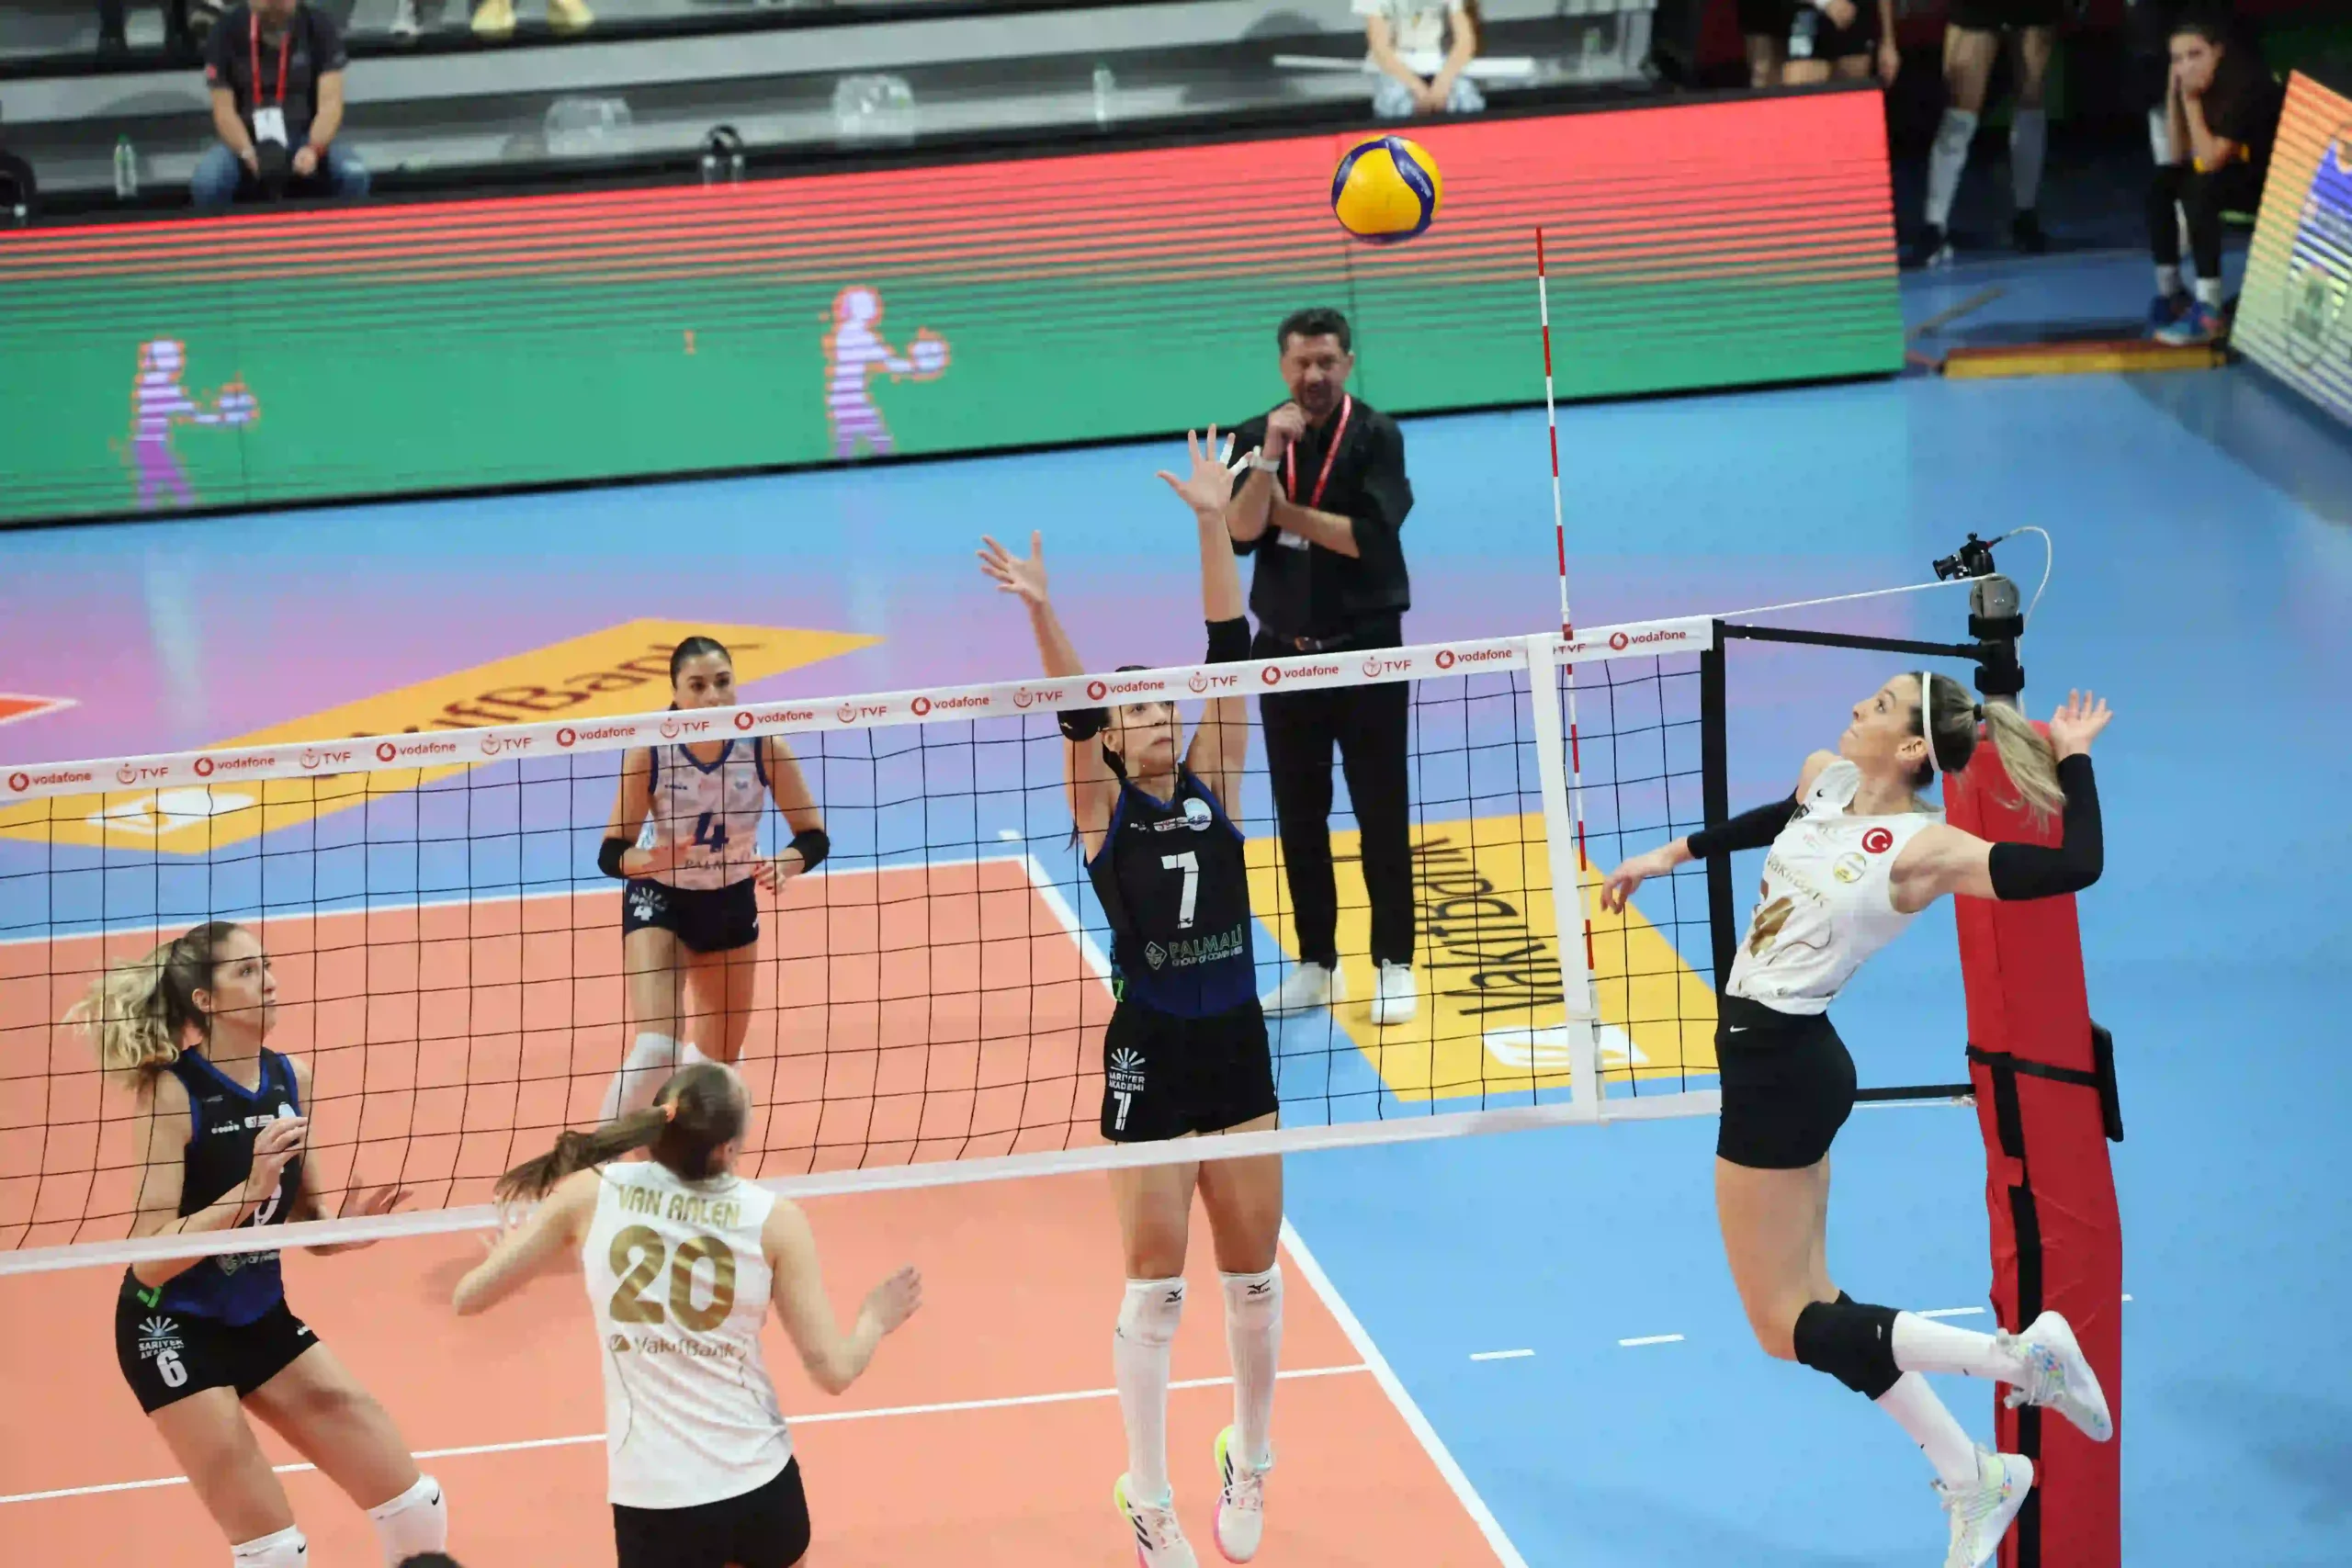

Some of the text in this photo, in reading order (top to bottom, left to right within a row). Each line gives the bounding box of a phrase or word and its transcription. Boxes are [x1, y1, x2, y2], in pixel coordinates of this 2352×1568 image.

[32, 630, 1687, 785] vodafone TVF vodafone TVF vodafone TVF vodafone TVF vodafone TVF vodafone TVF vodafone TVF vodafone TVF vodafone TVF vodafone
[694, 811, 729, 853] 4
[1160, 851, 1199, 930] 7
[1114, 1090, 1132, 1132] 7
[618, 1183, 741, 1229] VAN AALEN
[609, 1224, 736, 1333] 20
[156, 1348, 188, 1388] 6
